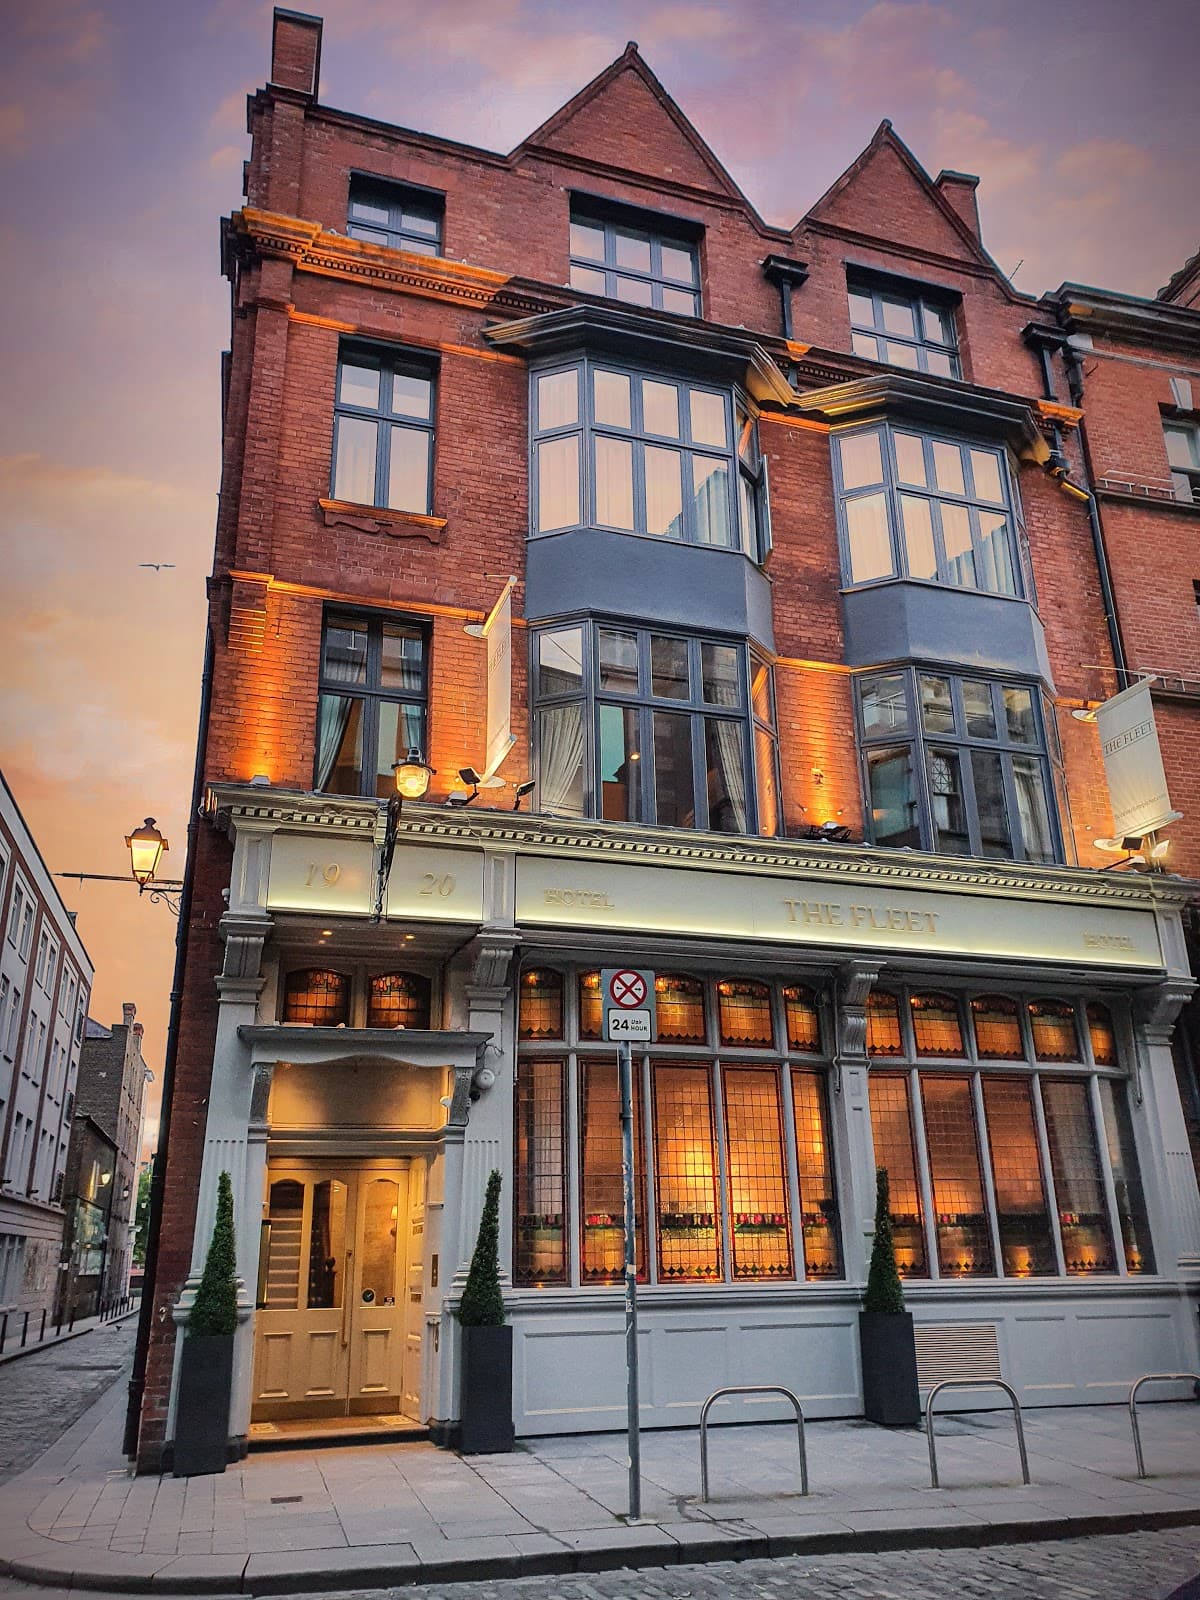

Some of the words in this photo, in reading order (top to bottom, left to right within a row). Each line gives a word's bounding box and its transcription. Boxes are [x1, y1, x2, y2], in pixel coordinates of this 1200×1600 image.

[1104, 737, 1122, 755] THE
[1123, 720, 1153, 745] FLEET
[305, 862, 341, 888] 19
[419, 872, 457, 897] 20
[544, 888, 616, 910] HOTEL
[784, 899, 844, 927] THE
[849, 903, 940, 934] FLEET
[613, 1019, 630, 1031] 24
